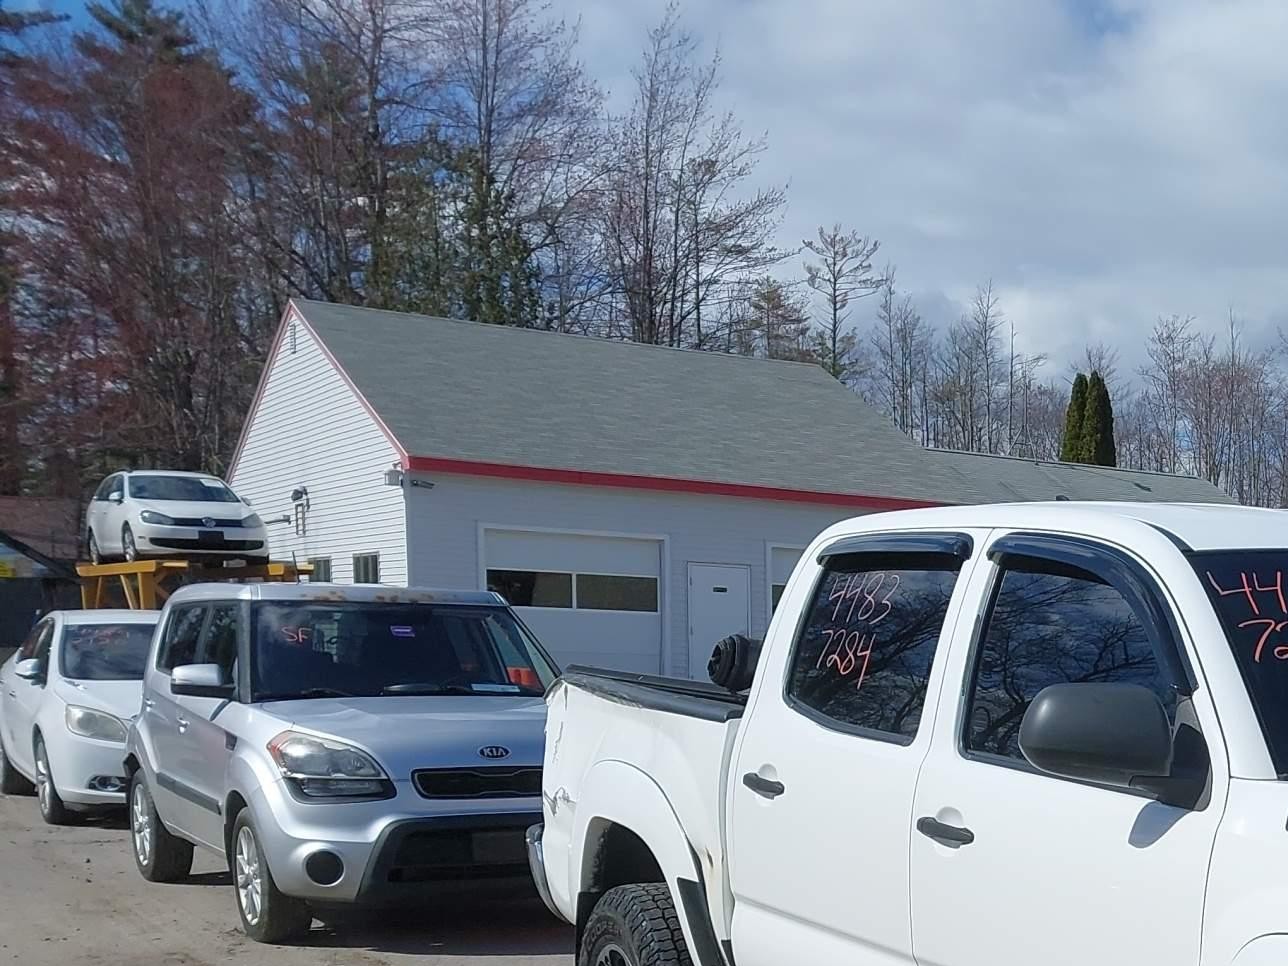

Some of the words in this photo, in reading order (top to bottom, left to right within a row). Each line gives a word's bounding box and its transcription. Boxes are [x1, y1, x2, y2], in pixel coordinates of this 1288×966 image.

[828, 573, 900, 625] 4483
[281, 625, 312, 643] SF
[816, 629, 877, 690] 7284
[482, 747, 506, 757] KIA
